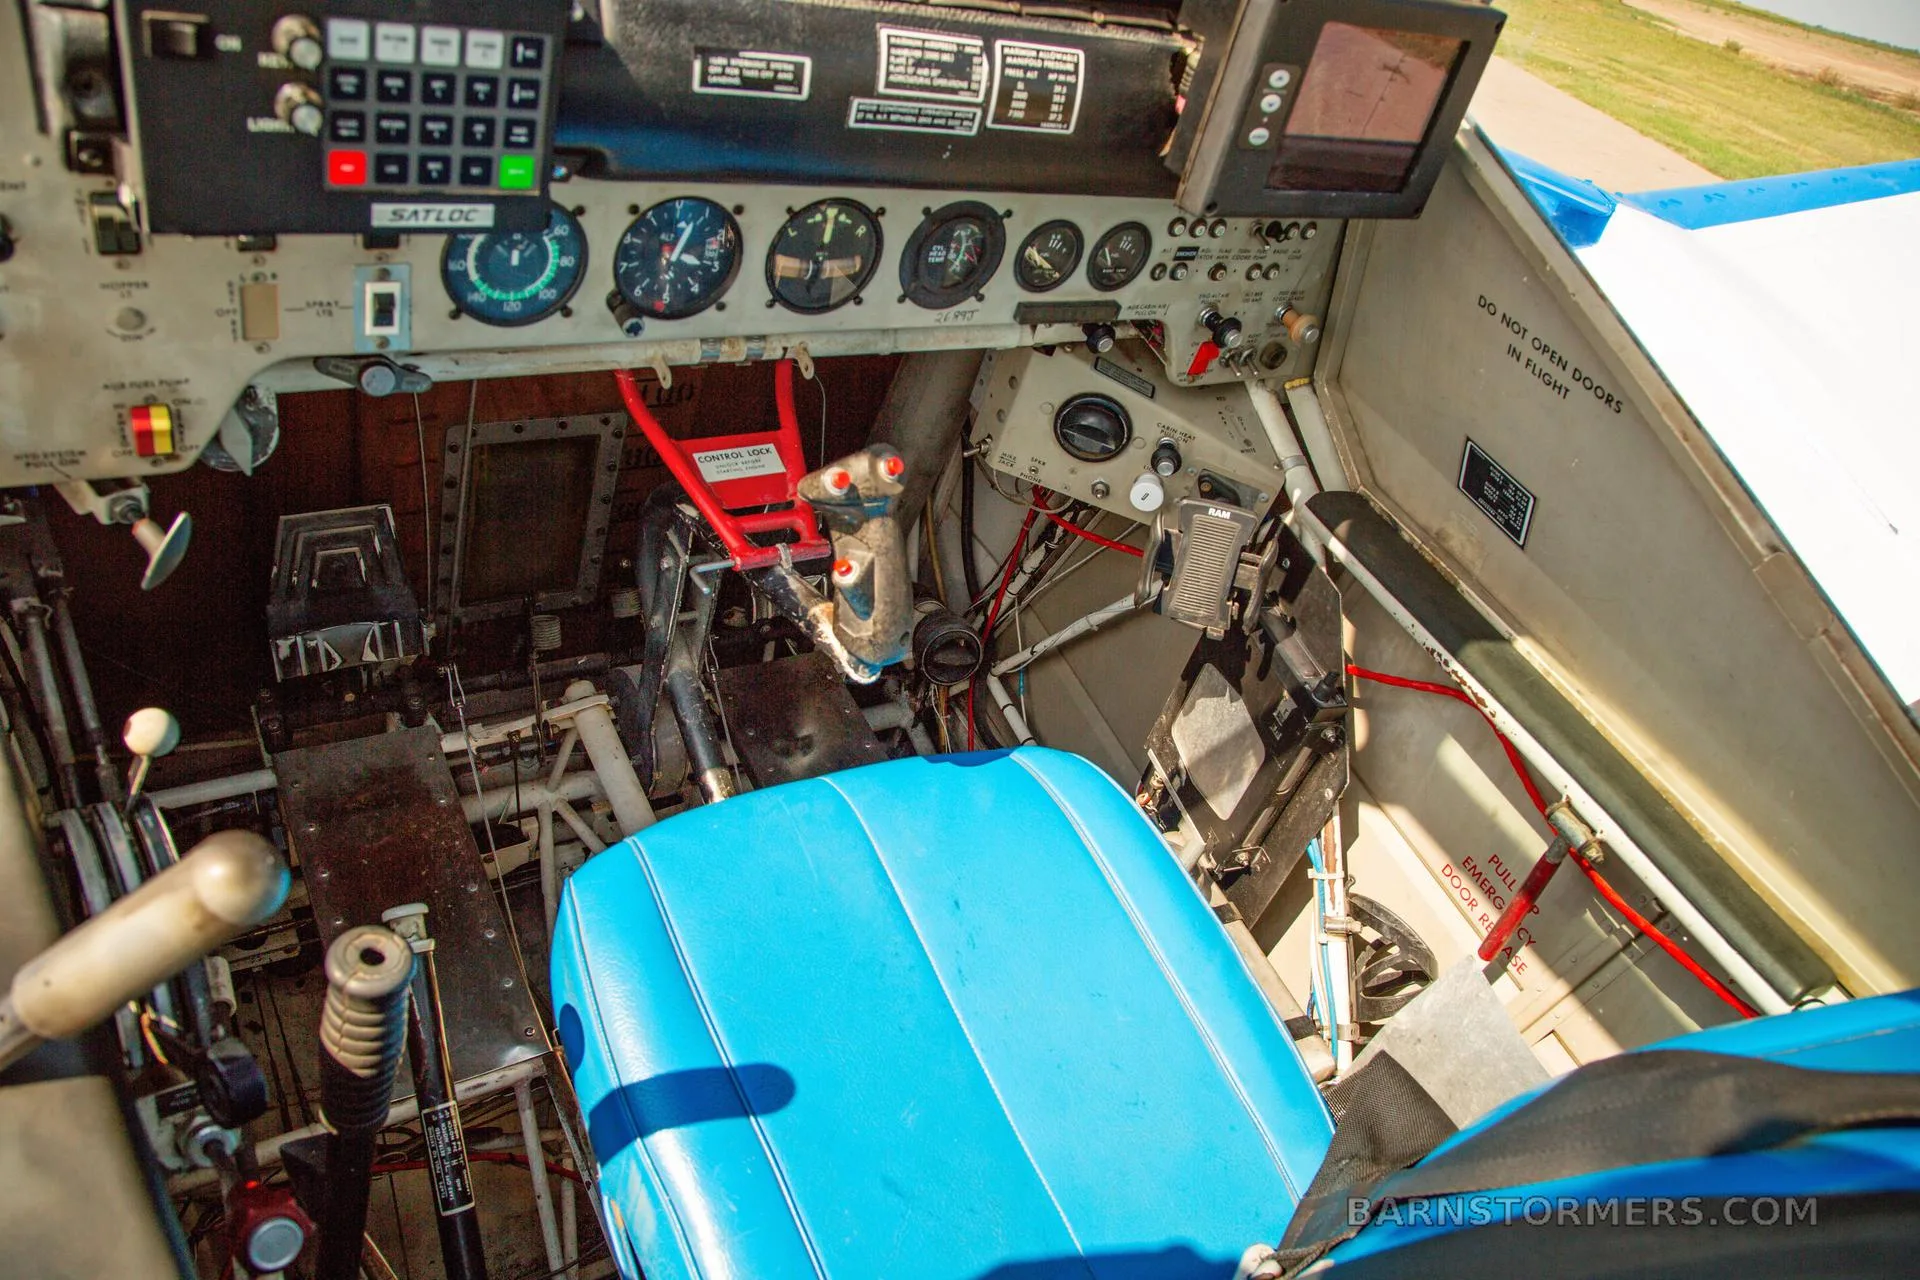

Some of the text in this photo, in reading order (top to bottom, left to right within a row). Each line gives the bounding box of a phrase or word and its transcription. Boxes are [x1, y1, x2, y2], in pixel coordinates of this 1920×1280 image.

[388, 208, 479, 223] SATLOC
[787, 227, 797, 238] L
[855, 226, 867, 238] R
[503, 301, 521, 312] 120
[1477, 295, 1624, 414] DO NOT OPEN DOORS
[1507, 343, 1571, 400] IN FLIGHT
[1156, 422, 1196, 441] CABIN HEAT
[698, 447, 772, 464] CONTROL LOCK
[1019, 472, 1042, 484] PHONE
[1208, 507, 1231, 519] RAM
[1488, 854, 1517, 892] PULL
[1462, 856, 1537, 948] EMERGCY
[1441, 863, 1528, 975] DOOR REASE
